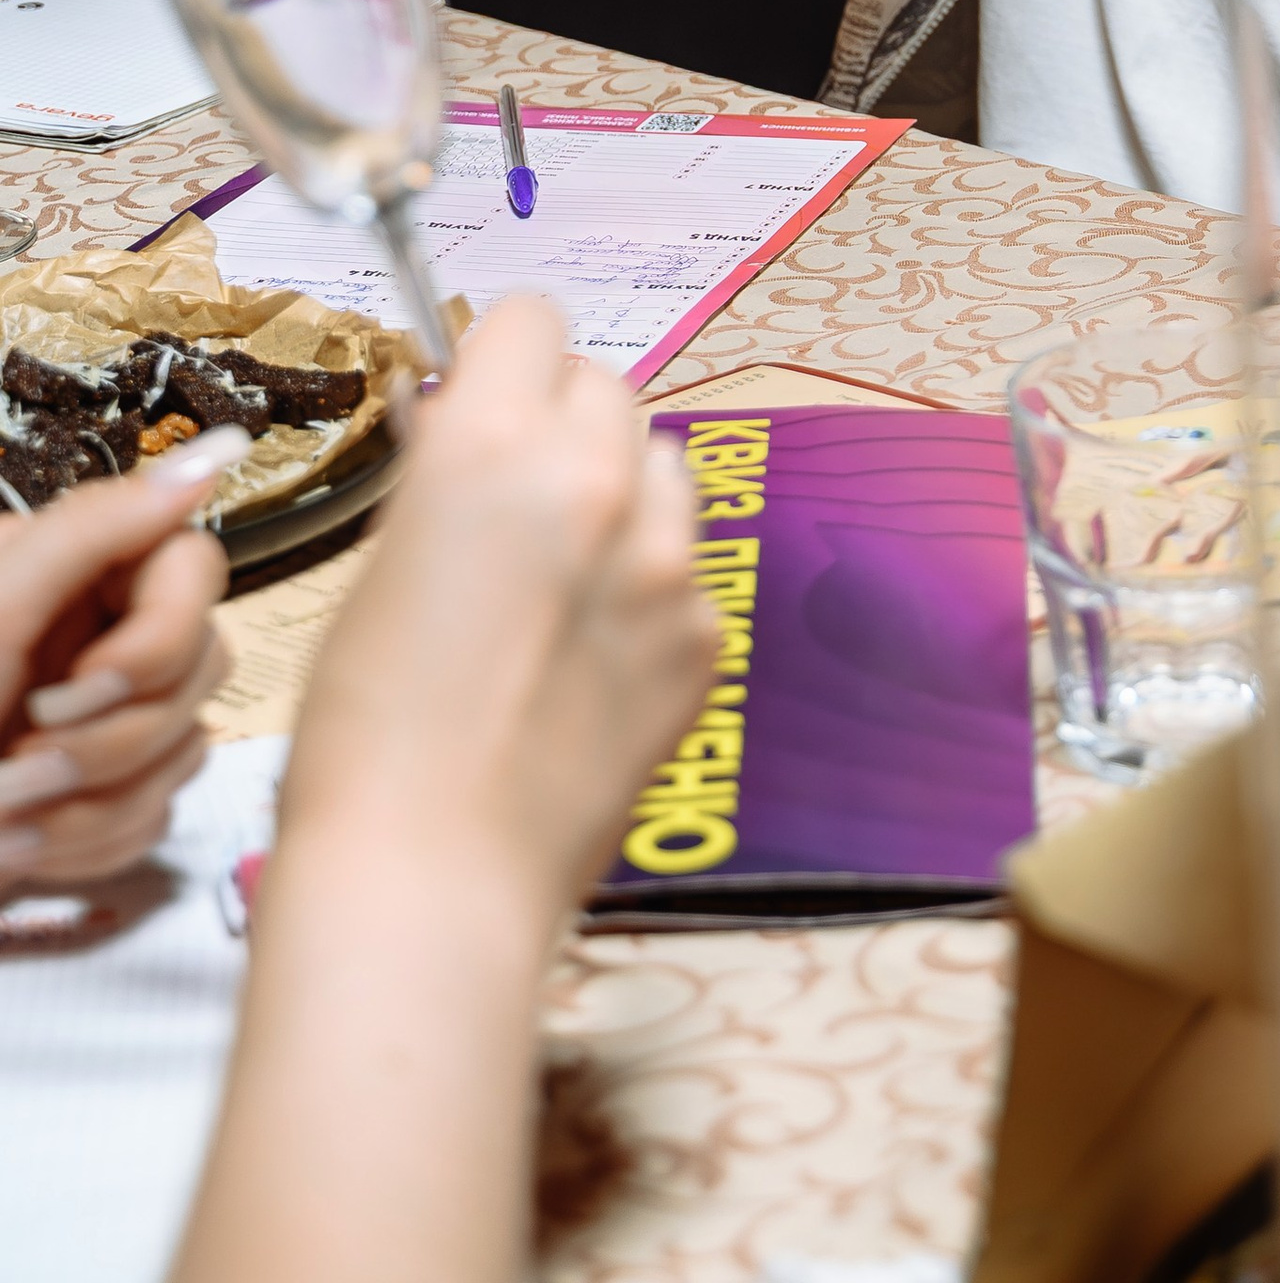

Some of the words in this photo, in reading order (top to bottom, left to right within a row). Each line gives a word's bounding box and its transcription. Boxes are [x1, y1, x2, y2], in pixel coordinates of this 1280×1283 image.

[426, 221, 484, 230] РАУНД
[703, 233, 761, 241] РАУНД
[586, 339, 648, 347] РАУНД
